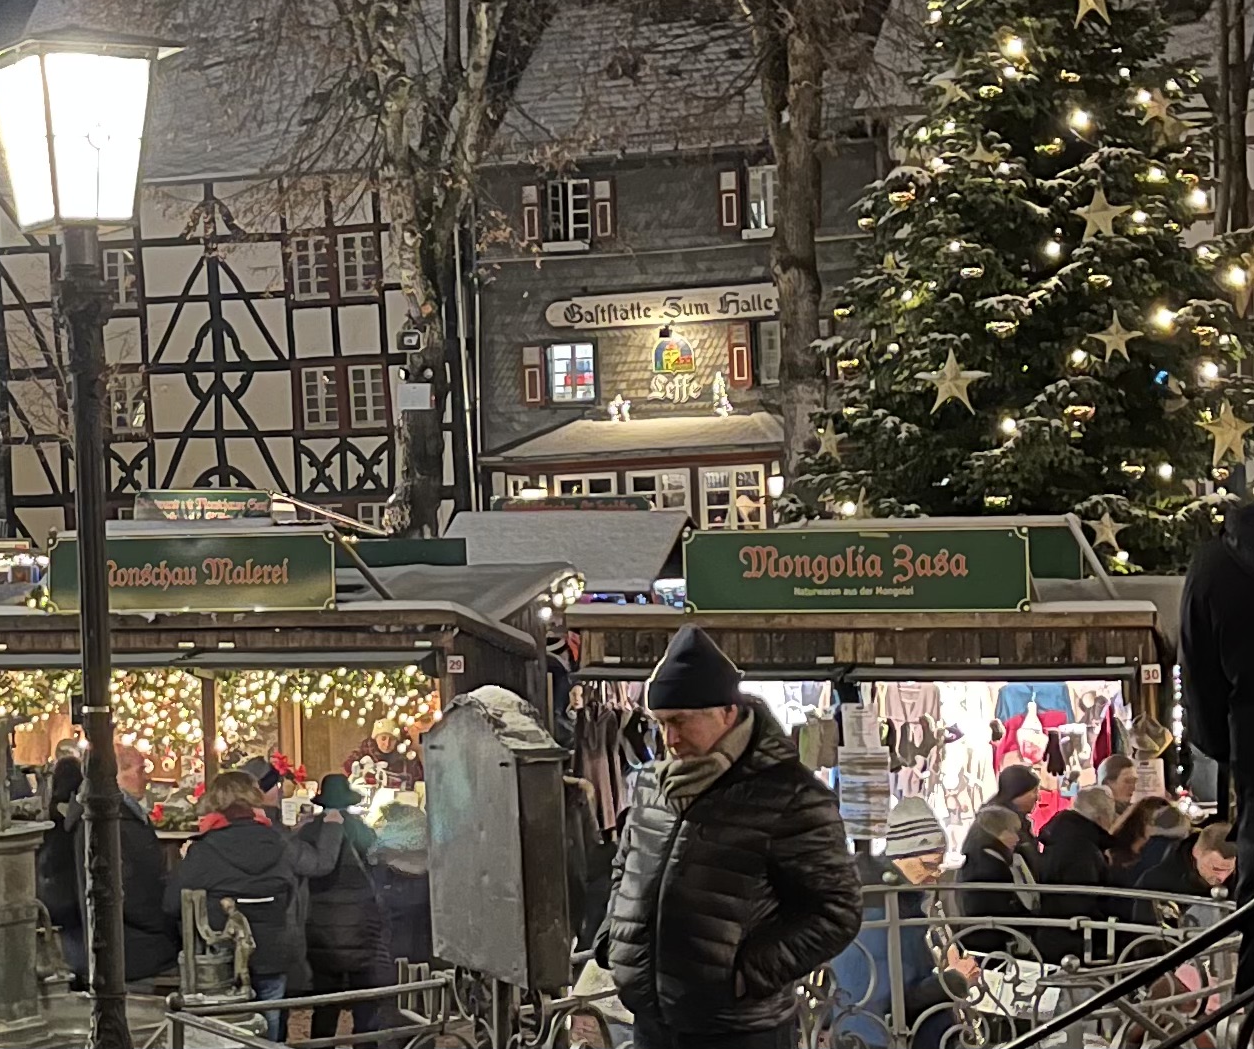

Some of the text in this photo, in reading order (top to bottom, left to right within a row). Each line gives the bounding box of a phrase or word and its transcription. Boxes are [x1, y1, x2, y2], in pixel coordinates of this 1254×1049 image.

[661, 295, 710, 319] Zum
[716, 291, 780, 315] Halle
[647, 373, 703, 404] Leffe
[201, 557, 290, 586] Malerei
[739, 545, 884, 585] Mongolia
[449, 659, 462, 670] 29
[1143, 668, 1159, 681] 30
